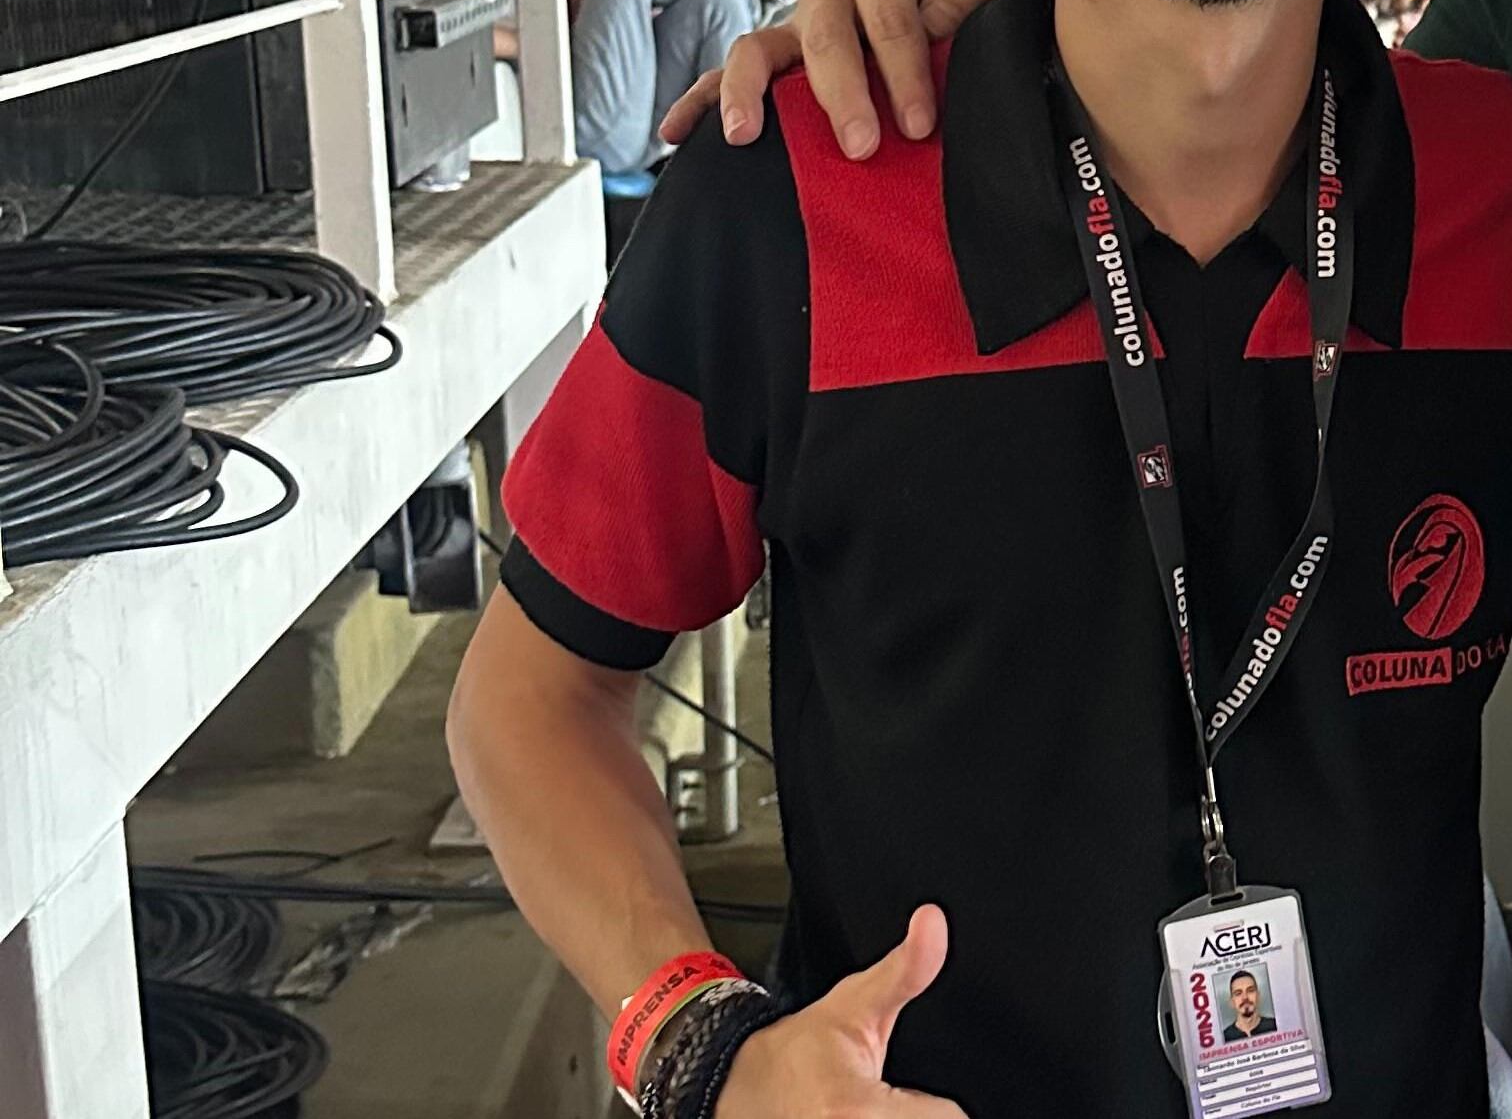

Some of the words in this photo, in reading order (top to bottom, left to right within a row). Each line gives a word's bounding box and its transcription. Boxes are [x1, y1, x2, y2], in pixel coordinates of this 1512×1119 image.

[1070, 137, 1145, 367] colunadofla.com
[1206, 535, 1328, 742] colunadofla.com
[1350, 655, 1448, 688] COLUNA
[1456, 645, 1482, 675] DO
[1200, 923, 1272, 958] ACERJ
[617, 965, 701, 1066] IMPRENSA
